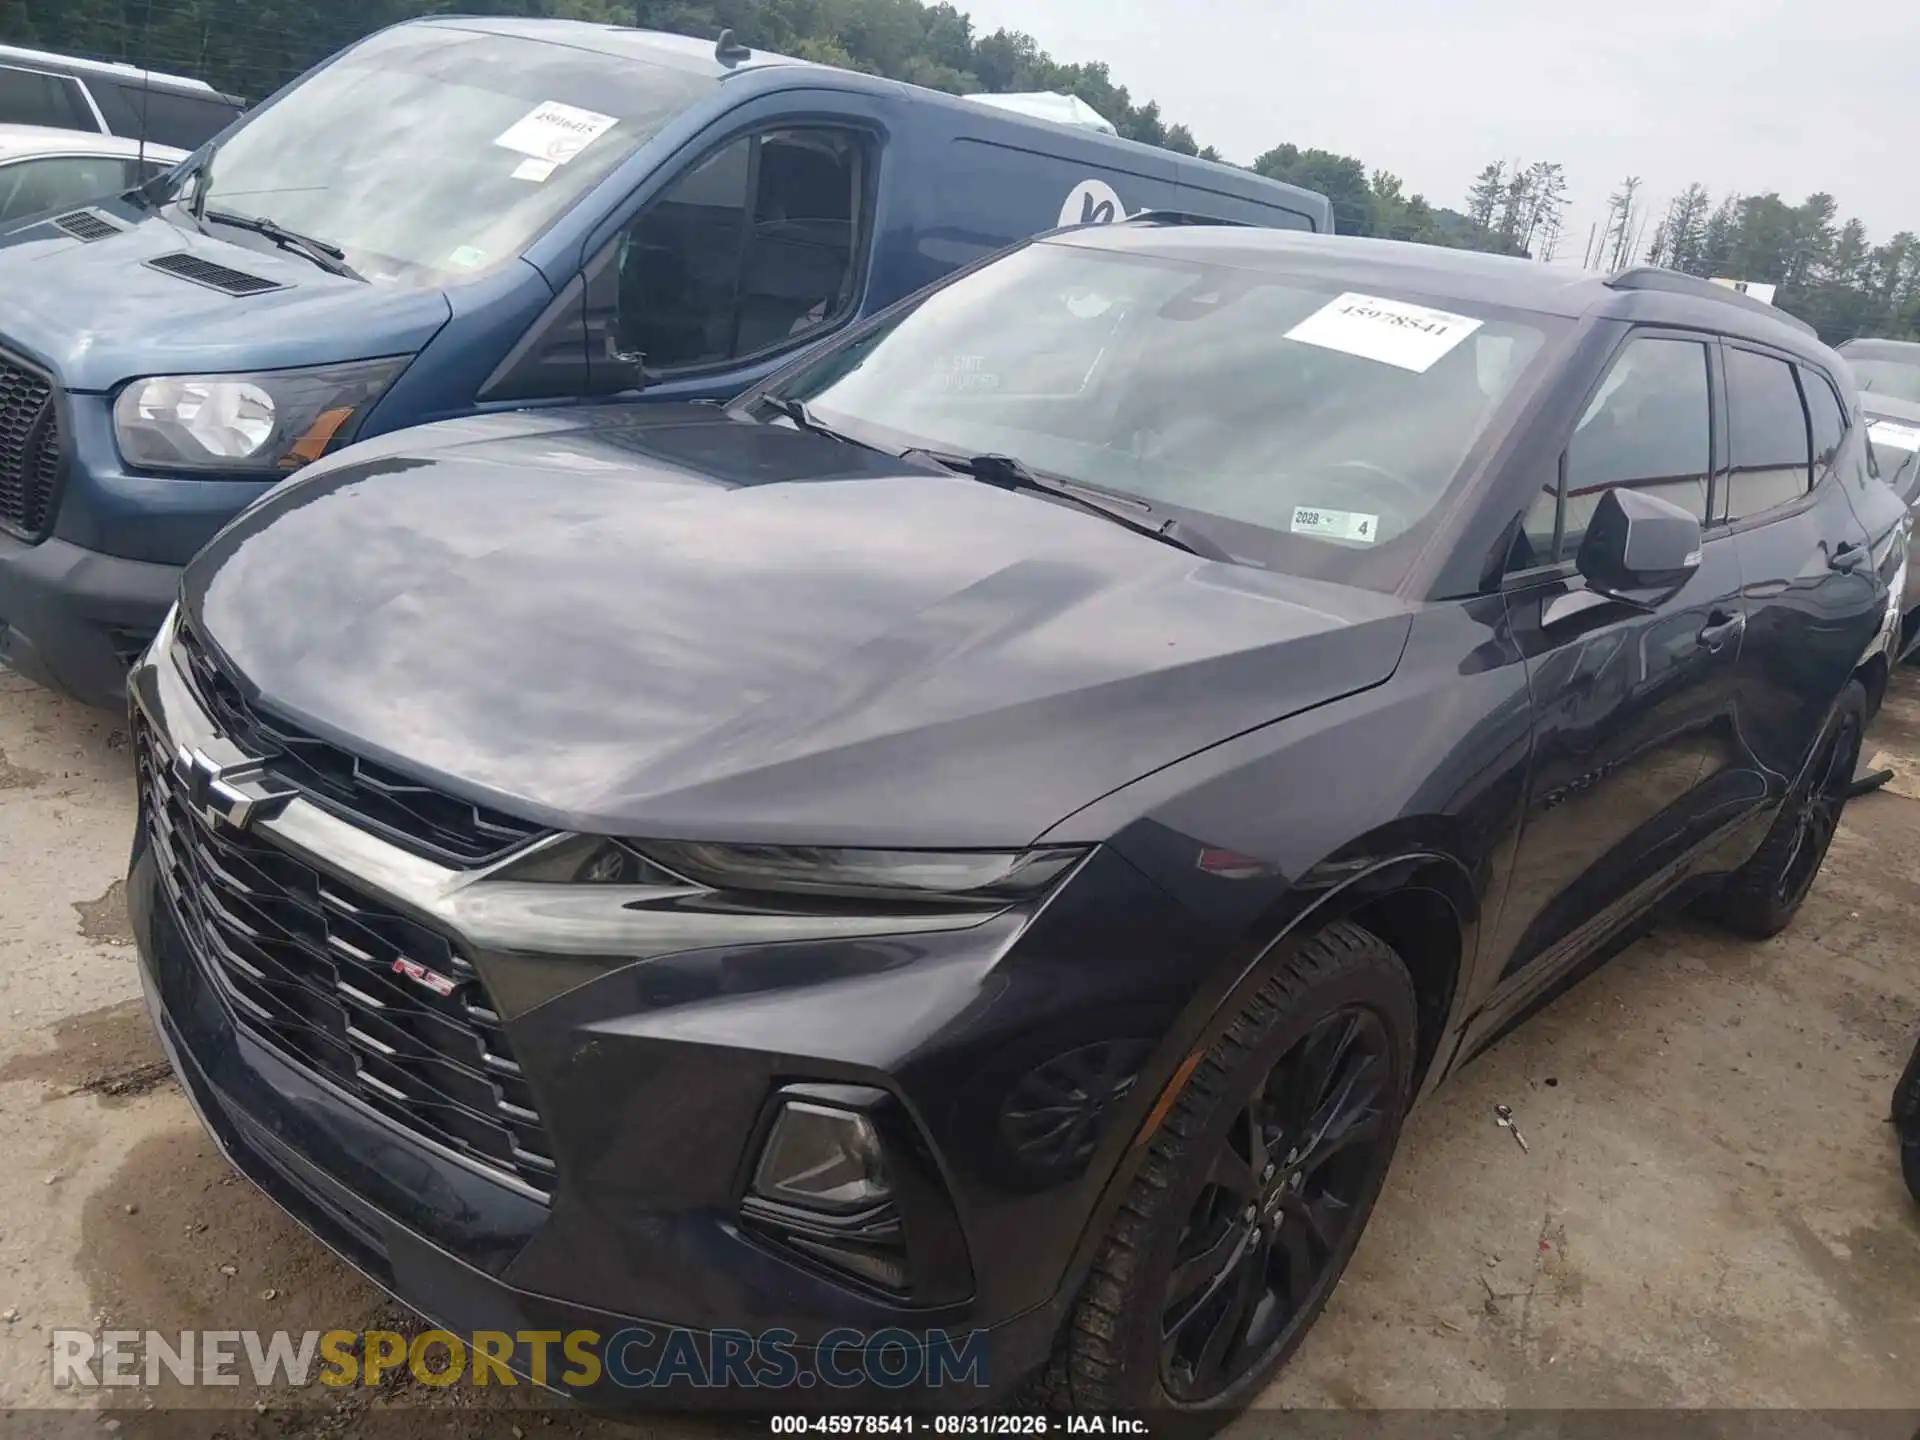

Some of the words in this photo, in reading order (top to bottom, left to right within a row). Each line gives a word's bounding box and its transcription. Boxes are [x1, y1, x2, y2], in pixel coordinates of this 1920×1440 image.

[1338, 305, 1449, 337] 45978541
[1358, 520, 1368, 536] 4
[392, 957, 456, 996] RS
